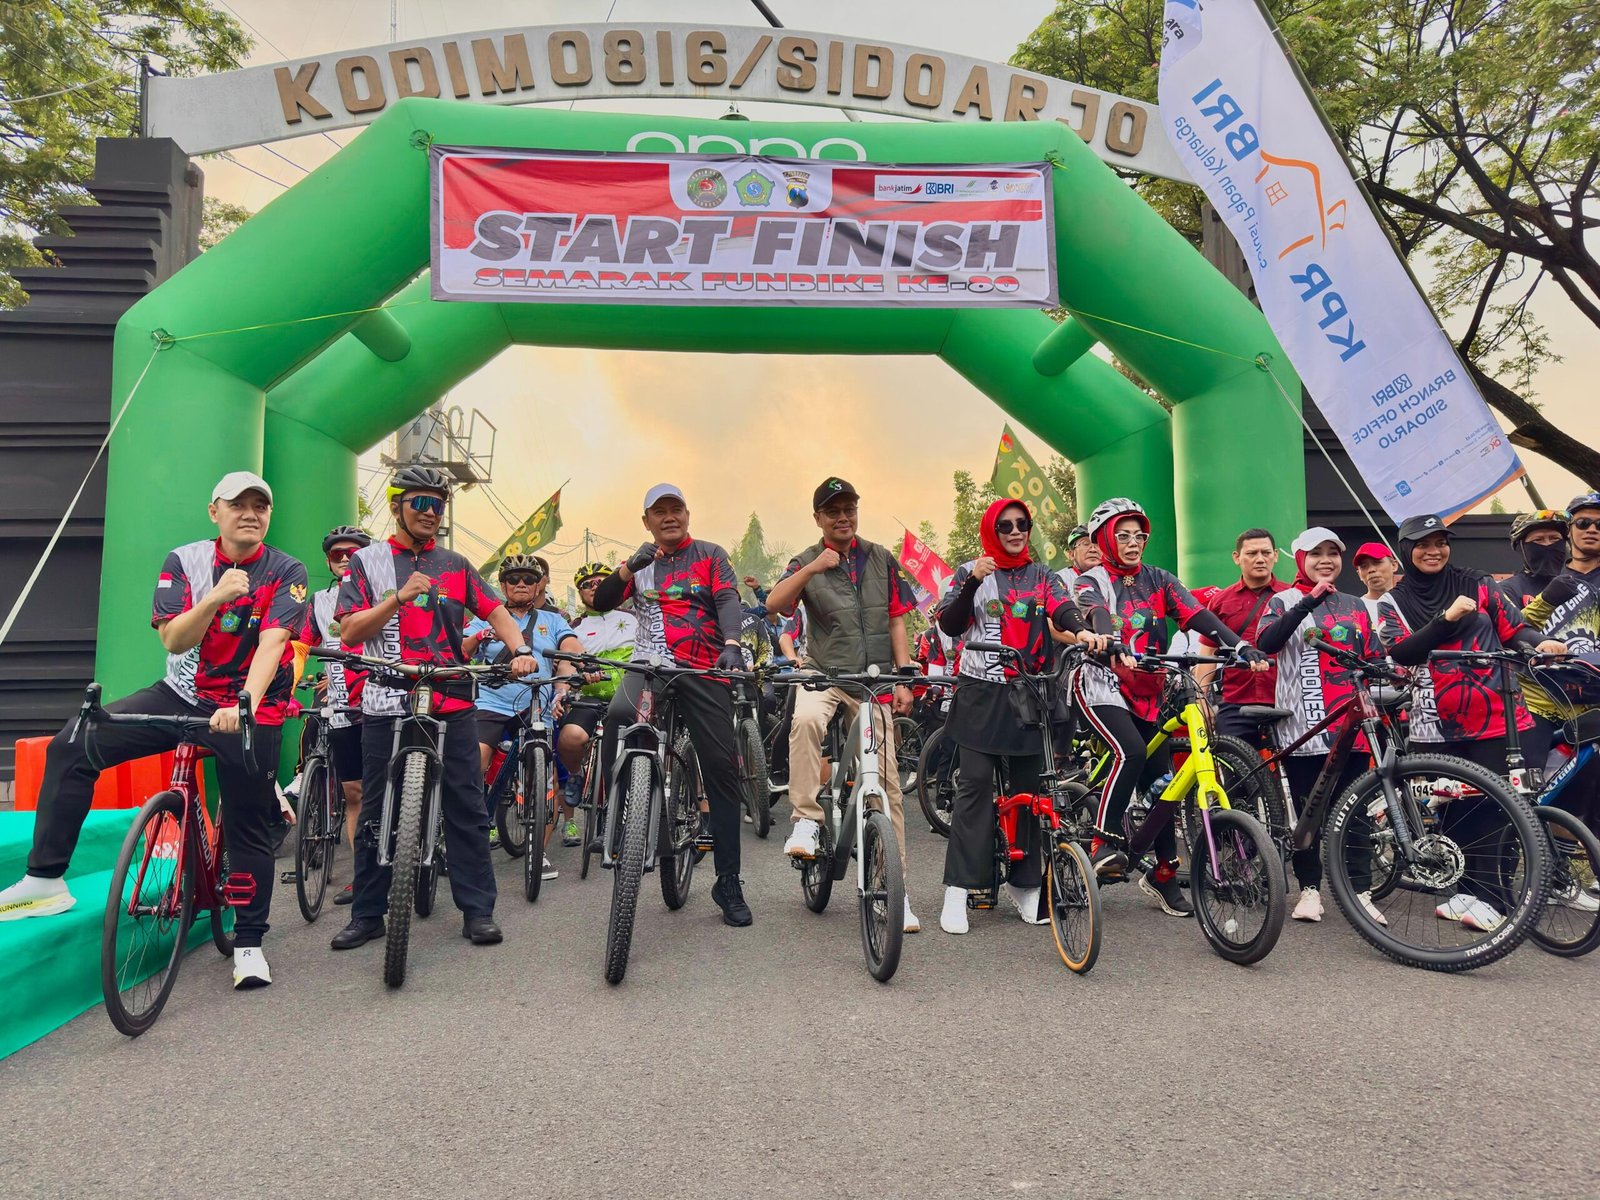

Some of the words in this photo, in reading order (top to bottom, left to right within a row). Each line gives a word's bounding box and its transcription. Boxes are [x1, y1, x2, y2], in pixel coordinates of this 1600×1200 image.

[879, 184, 912, 194] bankjatim
[938, 183, 954, 194] BRI
[470, 213, 731, 265] START
[752, 220, 1020, 269] FINISH
[474, 268, 694, 290] SEMARAK
[702, 272, 884, 292] FUNBIKE
[741, 616, 755, 630] IKE
[1300, 650, 1328, 736] INDONESI
[1412, 783, 1435, 797] 1945
[1465, 942, 1493, 957] TRAIL
[1491, 923, 1515, 945] BOSS
